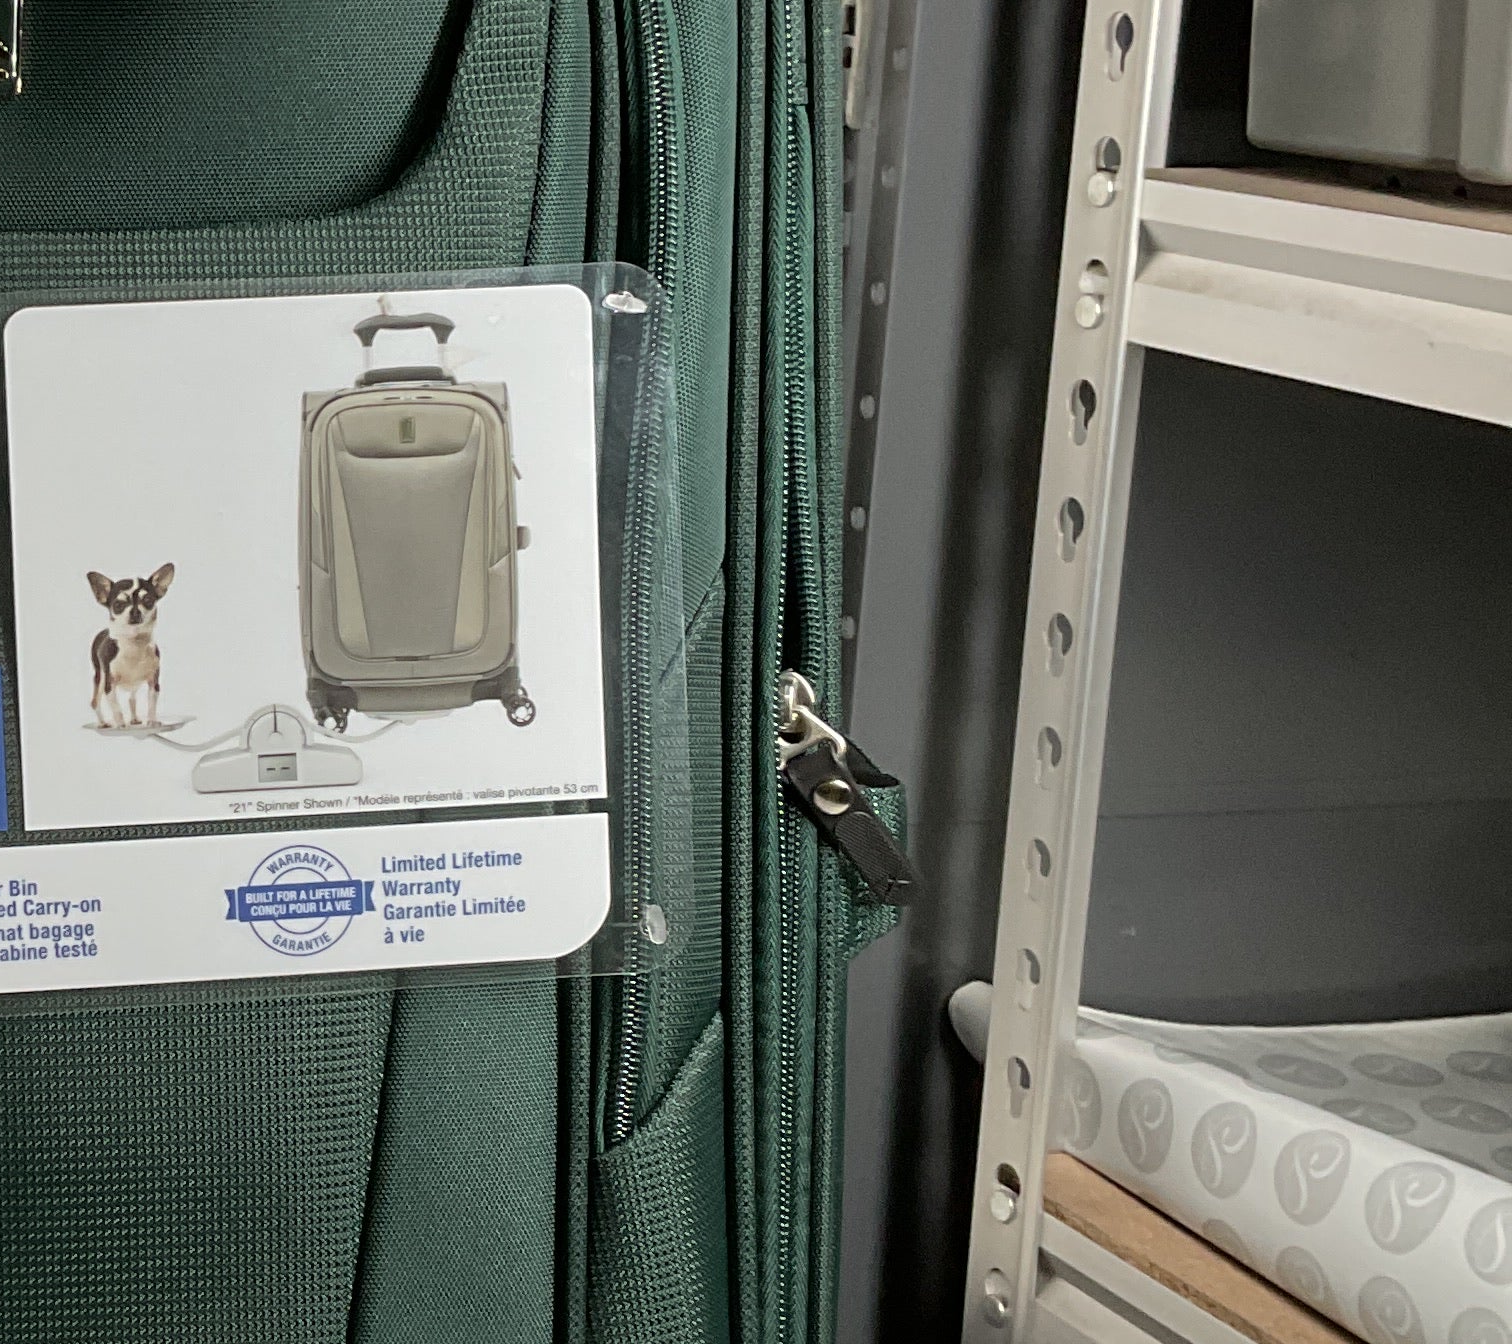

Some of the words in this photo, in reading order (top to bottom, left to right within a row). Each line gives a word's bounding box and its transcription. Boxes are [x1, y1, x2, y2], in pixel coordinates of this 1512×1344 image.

[256, 799, 300, 813] Spinner
[303, 797, 343, 810] Shown
[403, 790, 464, 806] représenté
[473, 787, 505, 800] valise
[508, 786, 560, 801] pivotante
[564, 784, 578, 795] 53
[581, 784, 599, 794] cm
[266, 852, 335, 876] WARRANTY
[381, 854, 446, 873] Limited
[452, 851, 522, 869] Lifetime
[9, 880, 37, 896] Bin
[246, 890, 274, 903] BUILT
[277, 889, 298, 901] FOR
[299, 888, 308, 900] A
[310, 886, 356, 900] LIFETIME
[382, 877, 461, 896] Warranty
[24, 899, 101, 917] Carry-on
[250, 902, 287, 918] CONÇU
[289, 901, 317, 914] POUR
[318, 900, 333, 912] LA
[335, 900, 352, 911] VIE
[384, 901, 456, 920] Garantie
[462, 896, 525, 915] Limitée
[30, 923, 94, 941] bagage
[384, 927, 394, 944] à
[400, 926, 425, 943] vie
[54, 940, 97, 958] testé
[272, 931, 333, 952] GARANTIE
